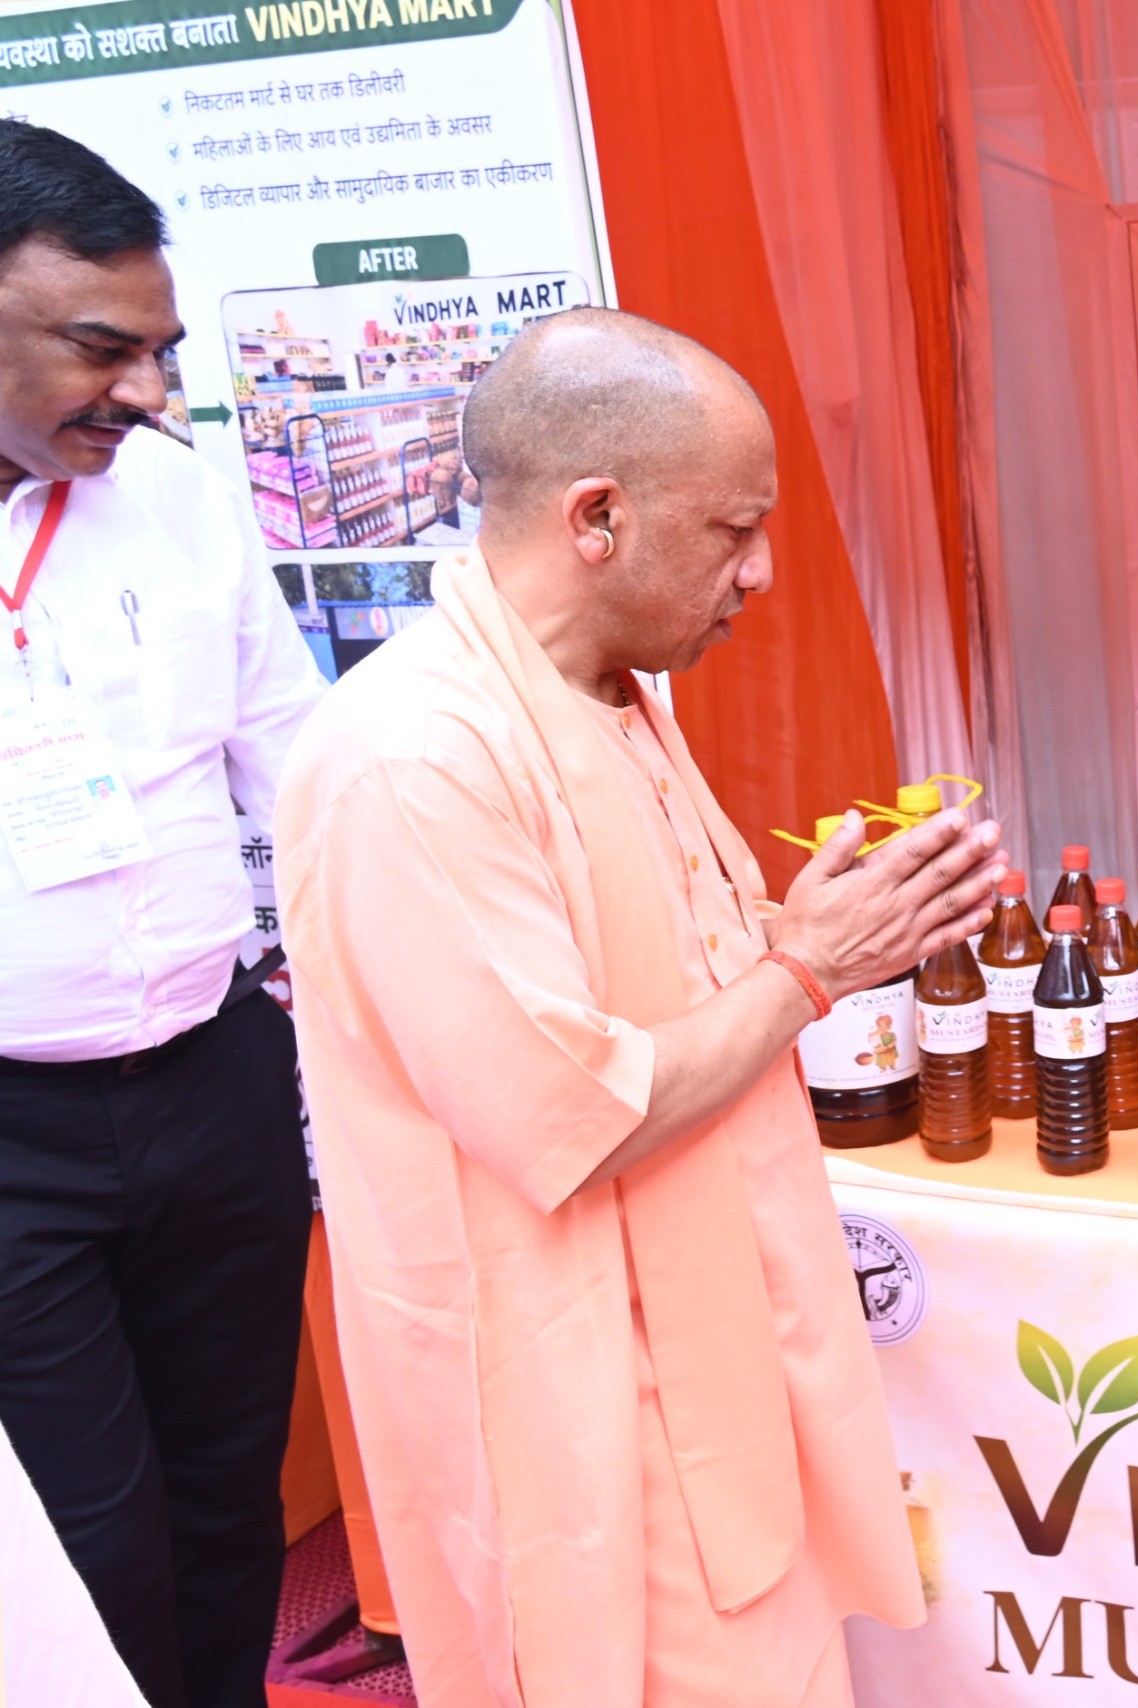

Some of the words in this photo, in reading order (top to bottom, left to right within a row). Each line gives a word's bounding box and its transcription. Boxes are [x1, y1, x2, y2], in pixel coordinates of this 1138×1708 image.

[61, 21, 95, 62] को
[96, 23, 169, 59] सशक्त
[169, 14, 240, 49] बनाता
[245, 0, 394, 42] VINDHYA
[184, 90, 245, 114] निकटतम
[249, 81, 275, 107] मार्ट
[278, 80, 292, 105] से
[295, 84, 314, 102] घर
[318, 81, 345, 100] तक
[348, 68, 405, 97] डिलीवरी
[192, 132, 253, 161] महिलाओं
[256, 130, 272, 152] के
[275, 128, 303, 153] लिए
[307, 130, 336, 149] आय
[339, 122, 361, 149] एवं
[426, 114, 441, 138] के
[447, 115, 493, 137] अवसर
[200, 184, 255, 210] डिजिटल
[258, 184, 302, 204] व्यापार
[307, 175, 329, 201] और
[334, 169, 409, 204] सामुदायिक
[413, 171, 456, 192] बाजार
[460, 169, 481, 189] का
[484, 159, 554, 189] एकीकरण
[358, 245, 419, 274] AFTER
[394, 295, 479, 326] VINDHYA
[497, 280, 566, 314] MART
[986, 976, 1034, 988] VINDH
